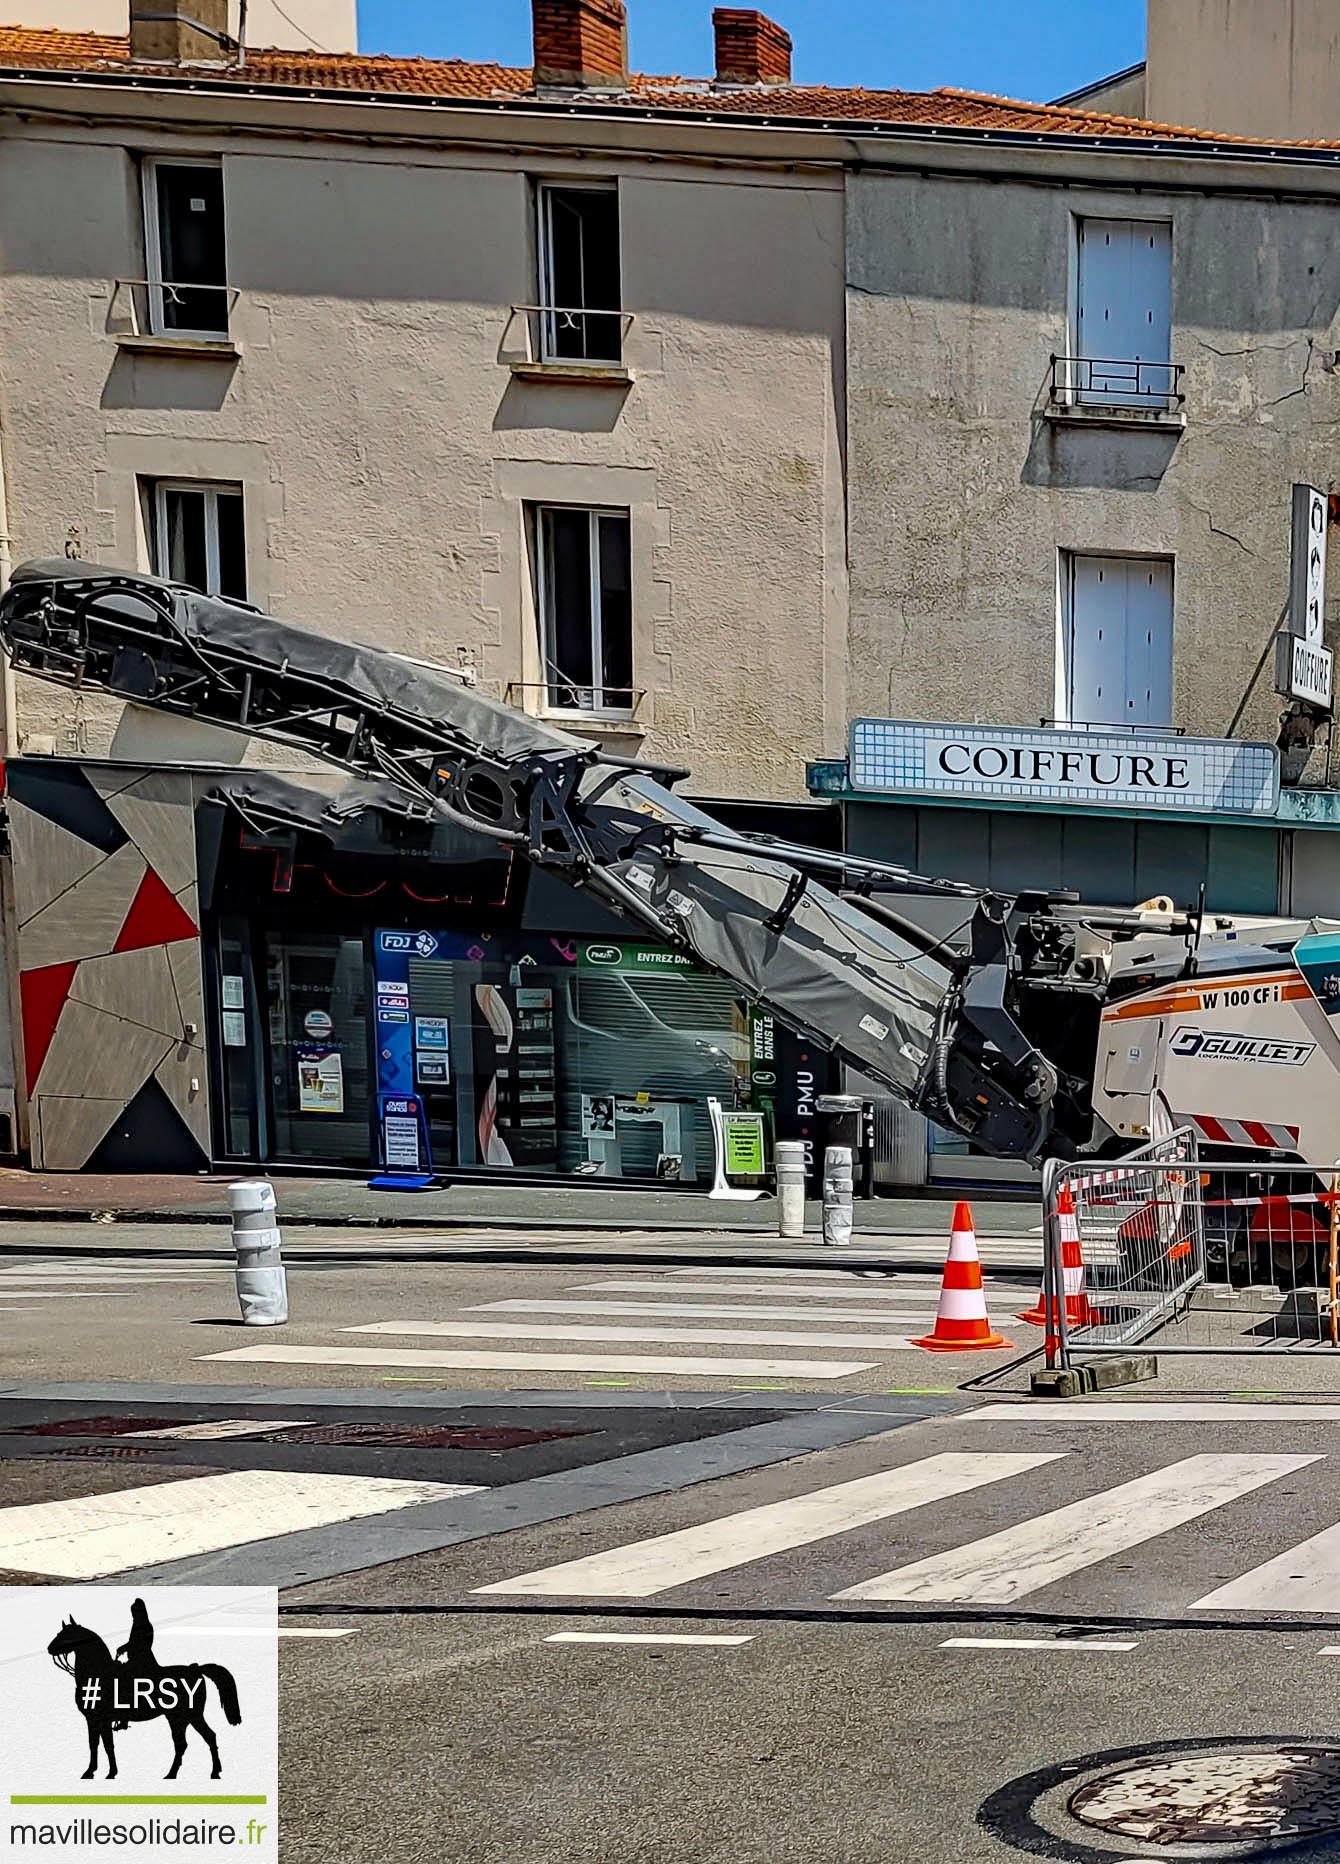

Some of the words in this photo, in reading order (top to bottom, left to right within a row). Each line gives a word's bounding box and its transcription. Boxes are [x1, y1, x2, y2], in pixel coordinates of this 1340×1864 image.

[1294, 647, 1330, 696] COIFFURE
[938, 743, 1190, 789] COIFFURE
[384, 935, 411, 948] FDJ
[637, 952, 674, 963] ENTREZ
[1202, 993, 1219, 1009] W
[1224, 990, 1250, 1007] 100
[764, 1016, 774, 1028] LE
[754, 1018, 764, 1059] ENTREZ
[764, 1030, 774, 1060] DANS
[1201, 1038, 1311, 1061] GUILLET
[797, 1072, 814, 1116] PMU
